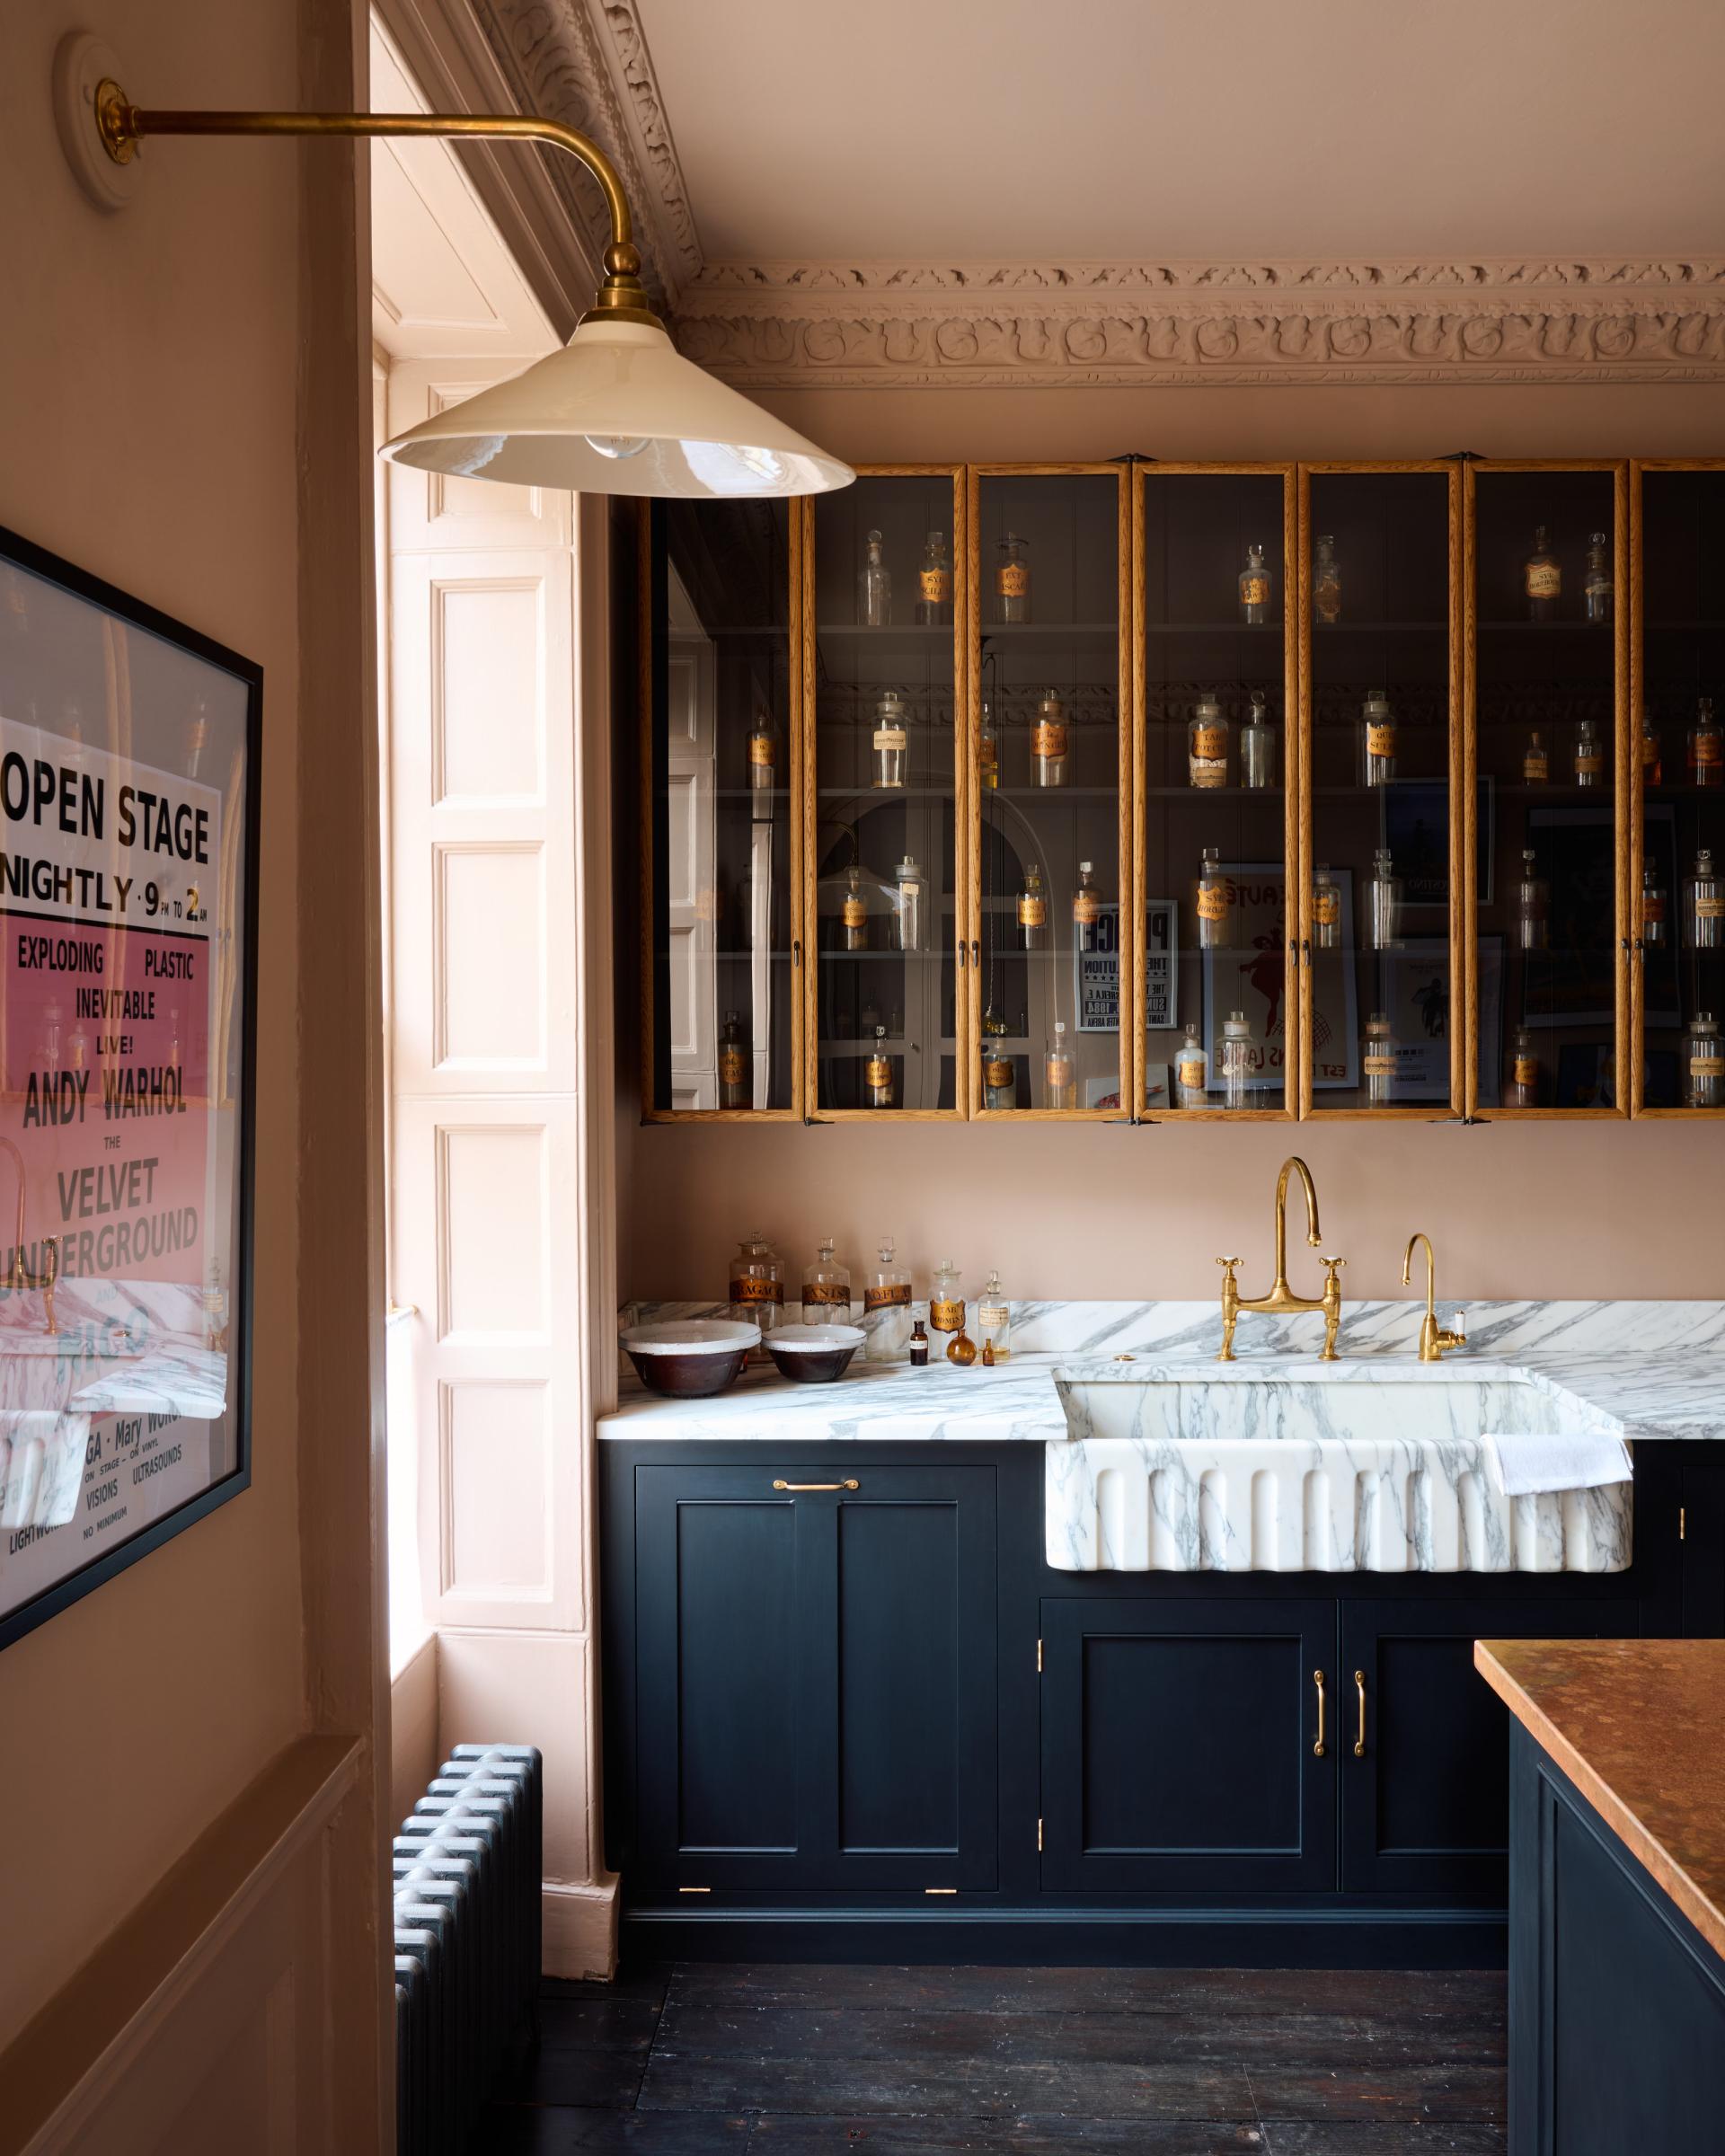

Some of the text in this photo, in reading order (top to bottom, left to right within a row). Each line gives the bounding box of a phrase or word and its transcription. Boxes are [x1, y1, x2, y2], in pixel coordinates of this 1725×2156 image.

[0, 752, 208, 865] OPEN STAGE
[0, 852, 133, 912] NIGHTLY
[173, 900, 182, 918] TO
[18, 935, 194, 980] EXPLODING PLASTIC
[75, 987, 155, 1020] INEVITABLE
[96, 1036, 133, 1055] LIVE!
[23, 1066, 186, 1128] ANDY WARHOL
[104, 1135, 120, 1150] THE
[58, 1157, 159, 1222] VELVET
[115, 1417, 142, 1452] Mary
[84, 1438, 159, 1483] ON STAGE ON VINYL
[86, 1444, 182, 1511] VISIONS ULTRASOUNDS
[83, 1506, 128, 1541] NO MINIMUM
